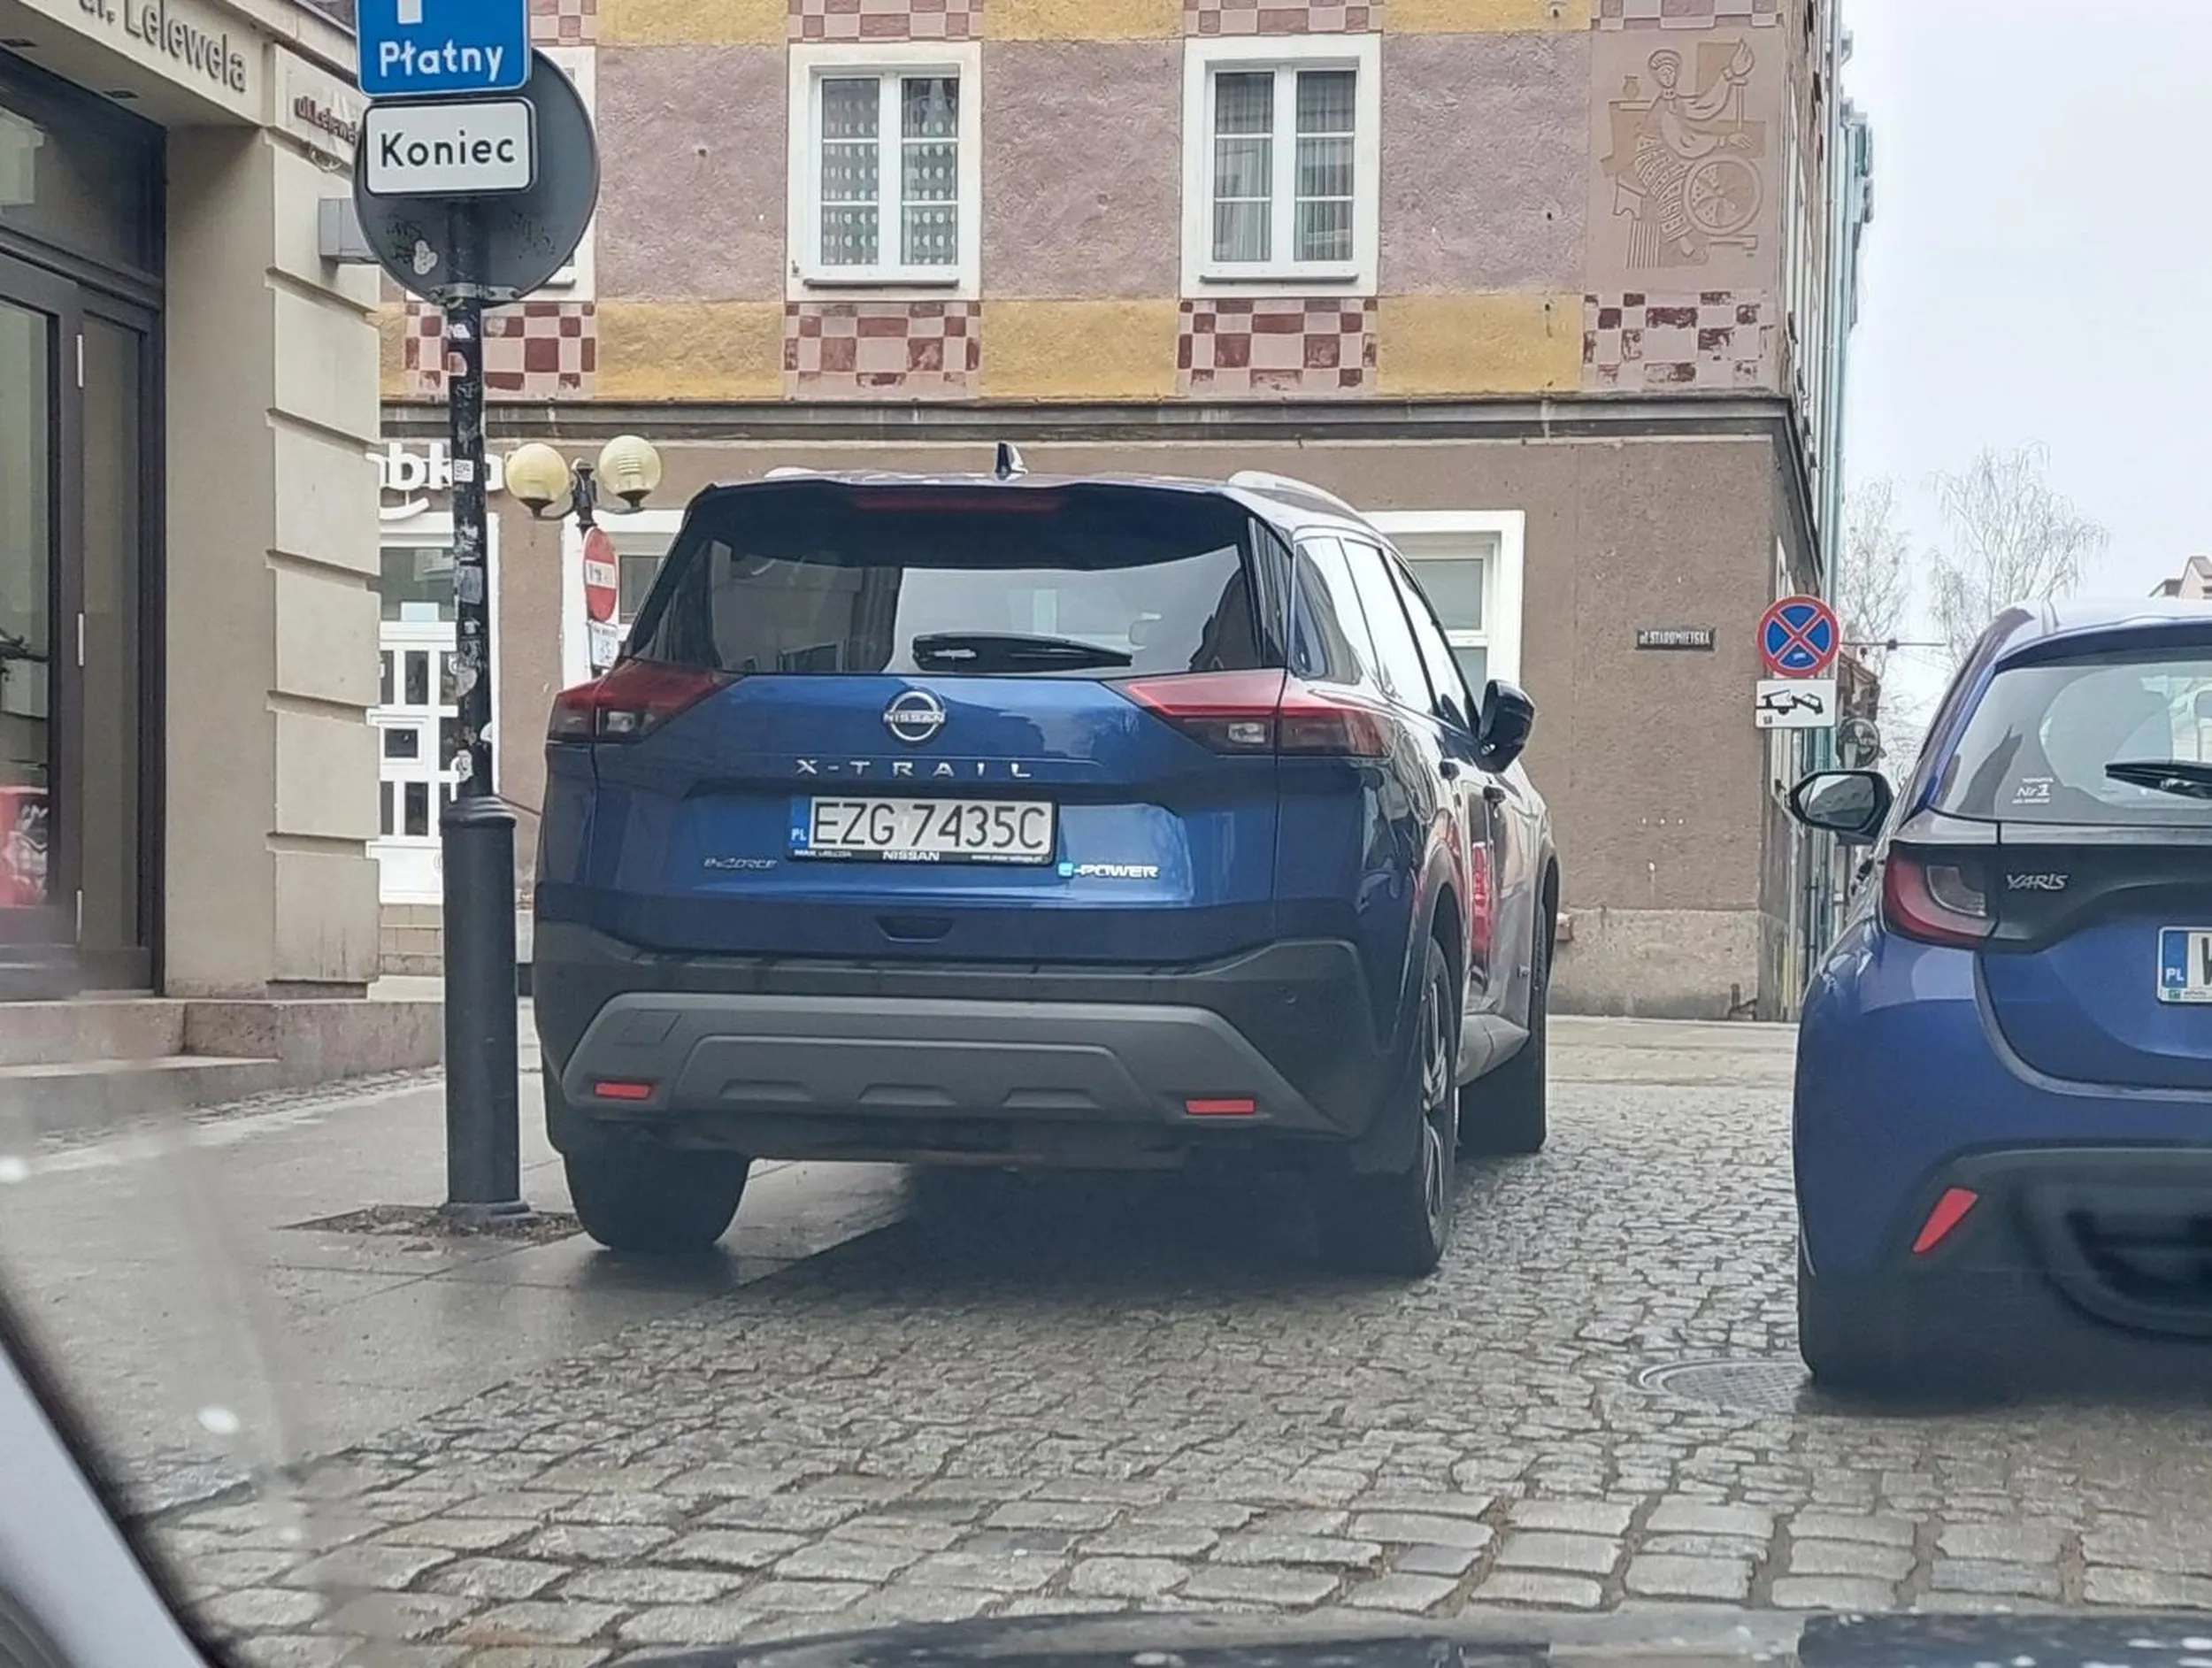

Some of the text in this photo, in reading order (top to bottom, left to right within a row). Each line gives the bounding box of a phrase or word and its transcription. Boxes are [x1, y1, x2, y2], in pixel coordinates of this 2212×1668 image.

[379, 39, 503, 82] Płatny
[380, 129, 515, 167] Koniec
[796, 758, 1032, 778] X-TRAIL
[791, 828, 807, 842] PL
[813, 802, 1046, 849] EZG 7435C
[883, 850, 941, 862] NISSAN
[2007, 872, 2070, 890] YARIS
[2165, 967, 2185, 982] PL
